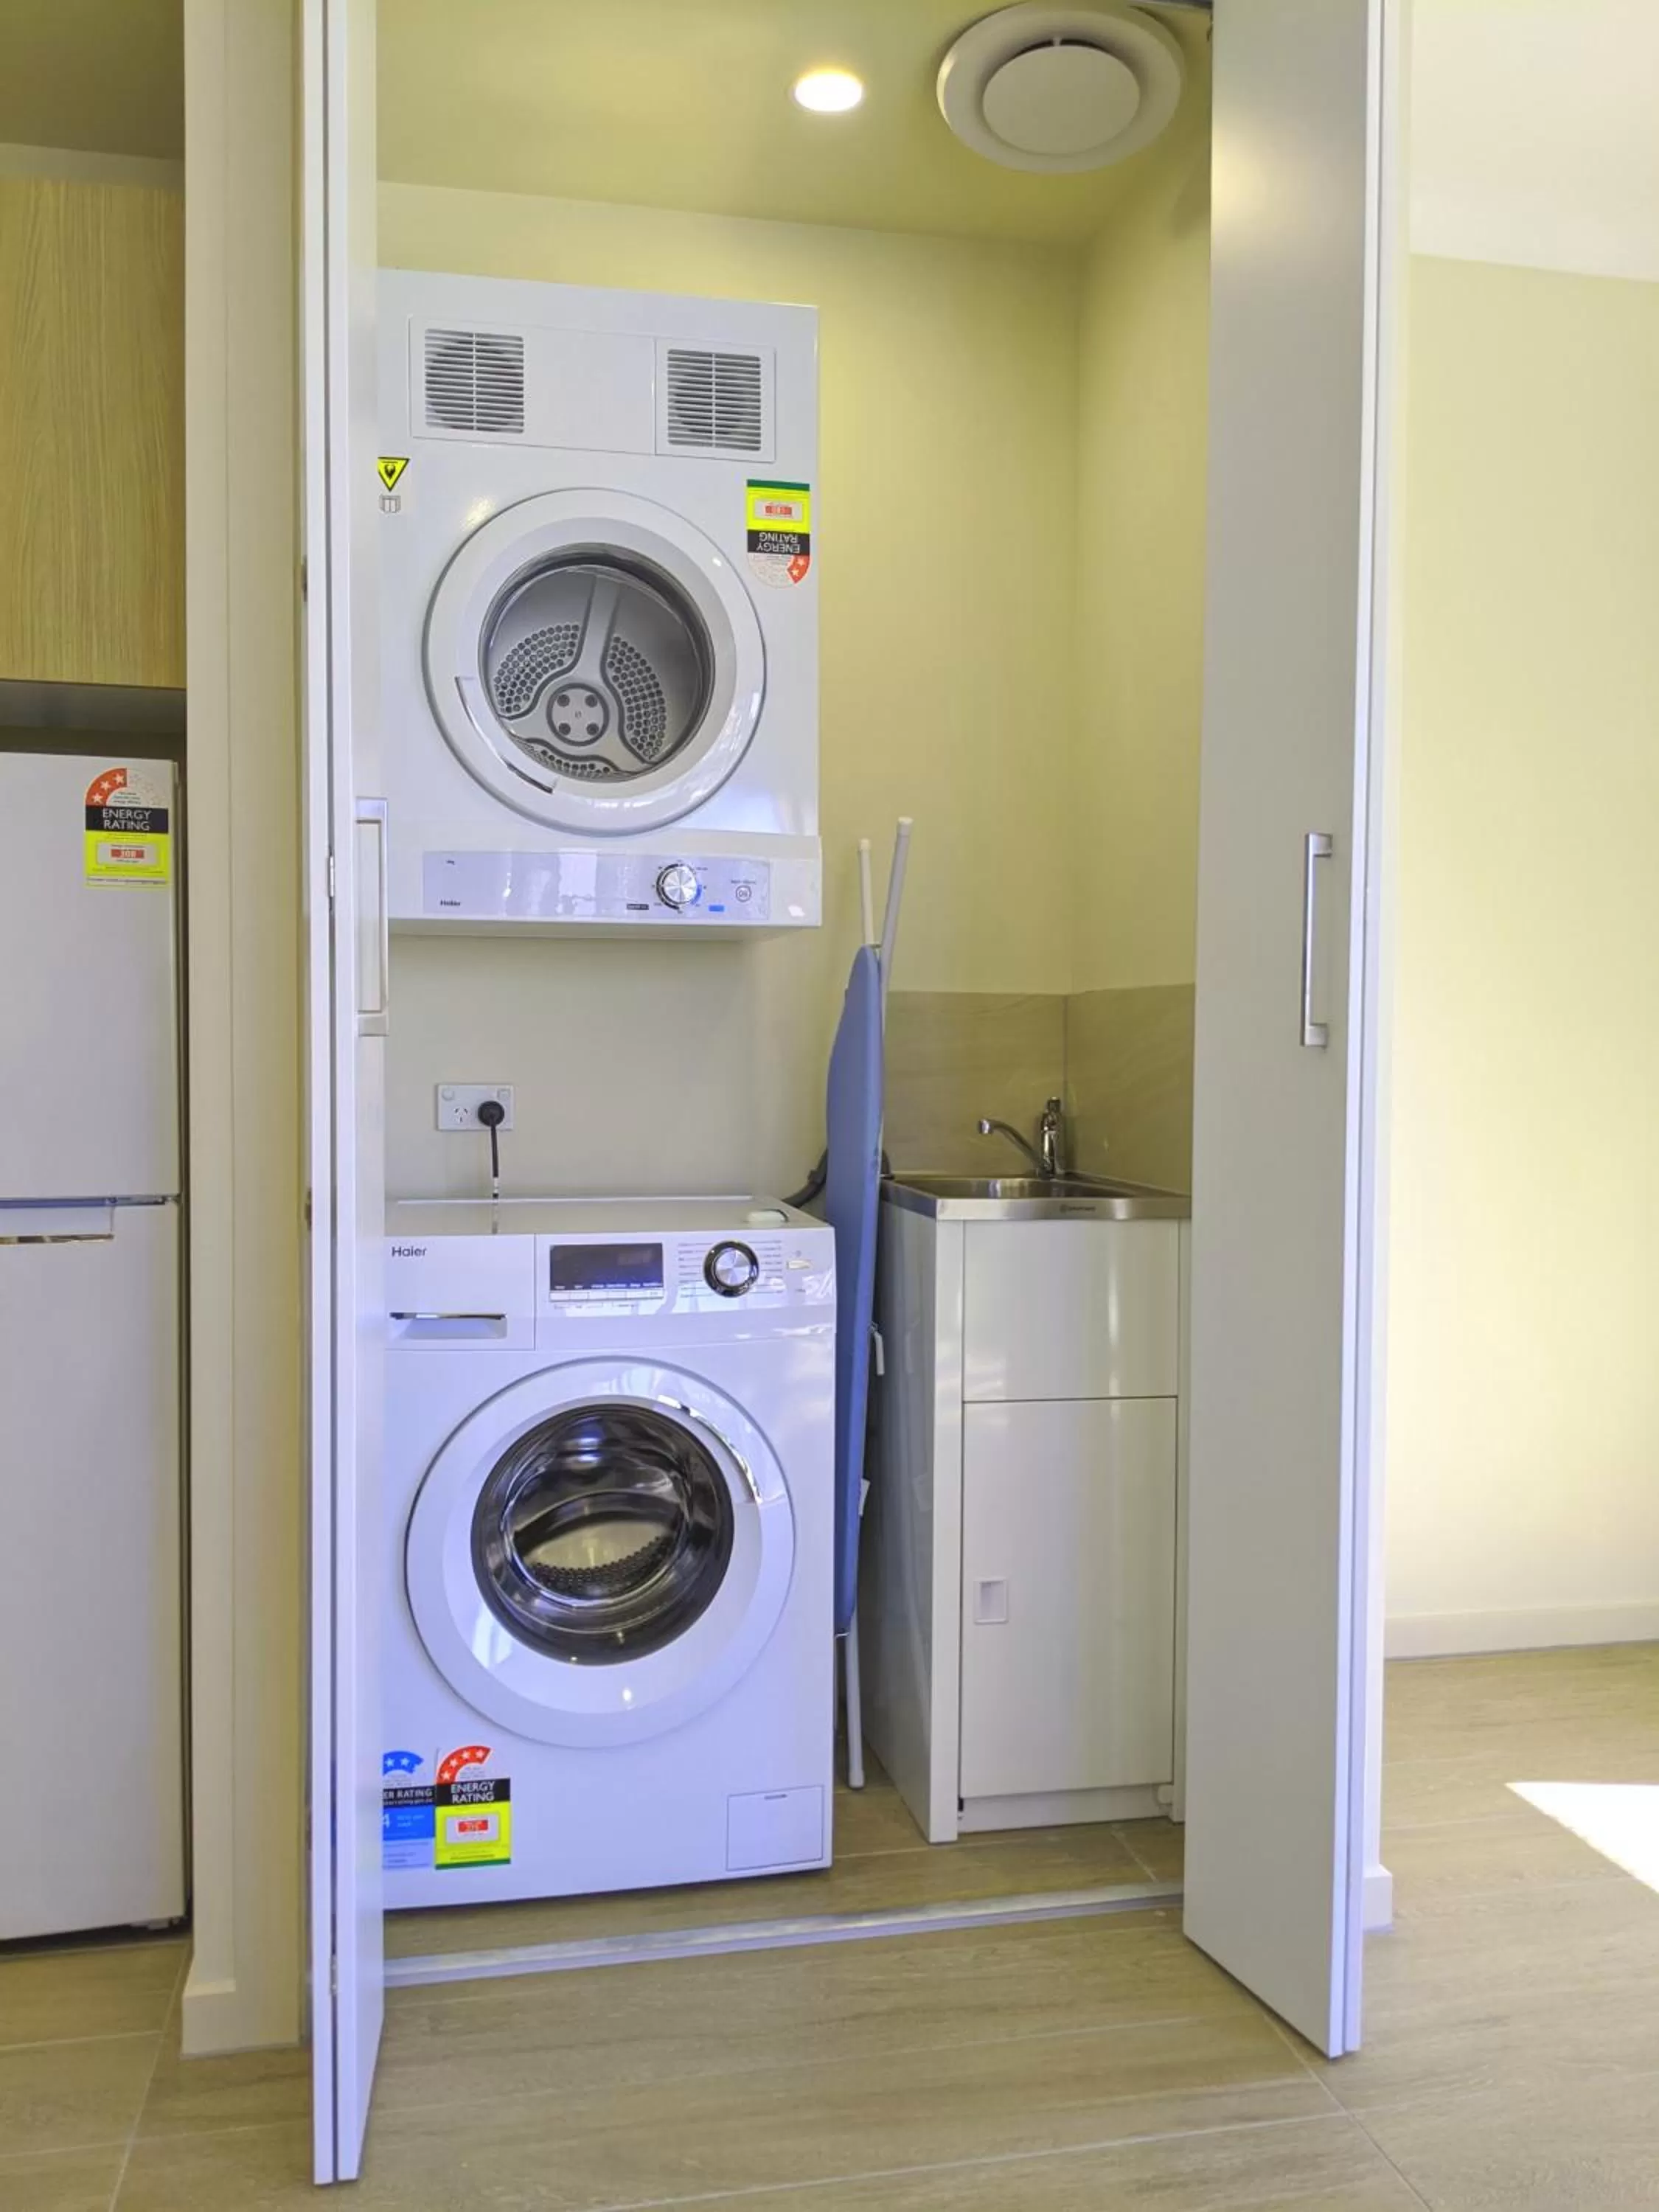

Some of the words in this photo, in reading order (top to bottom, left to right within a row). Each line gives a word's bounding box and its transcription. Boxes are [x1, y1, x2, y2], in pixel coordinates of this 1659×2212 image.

[759, 532, 799, 543] RATING
[756, 542, 801, 554] ENERGY
[102, 808, 151, 821] ENERGY
[104, 819, 150, 831] RATING
[392, 1245, 427, 1257] Haier
[397, 1788, 433, 1798] RATING
[451, 1781, 495, 1794] ENERGY
[452, 1792, 495, 1804] RATING
